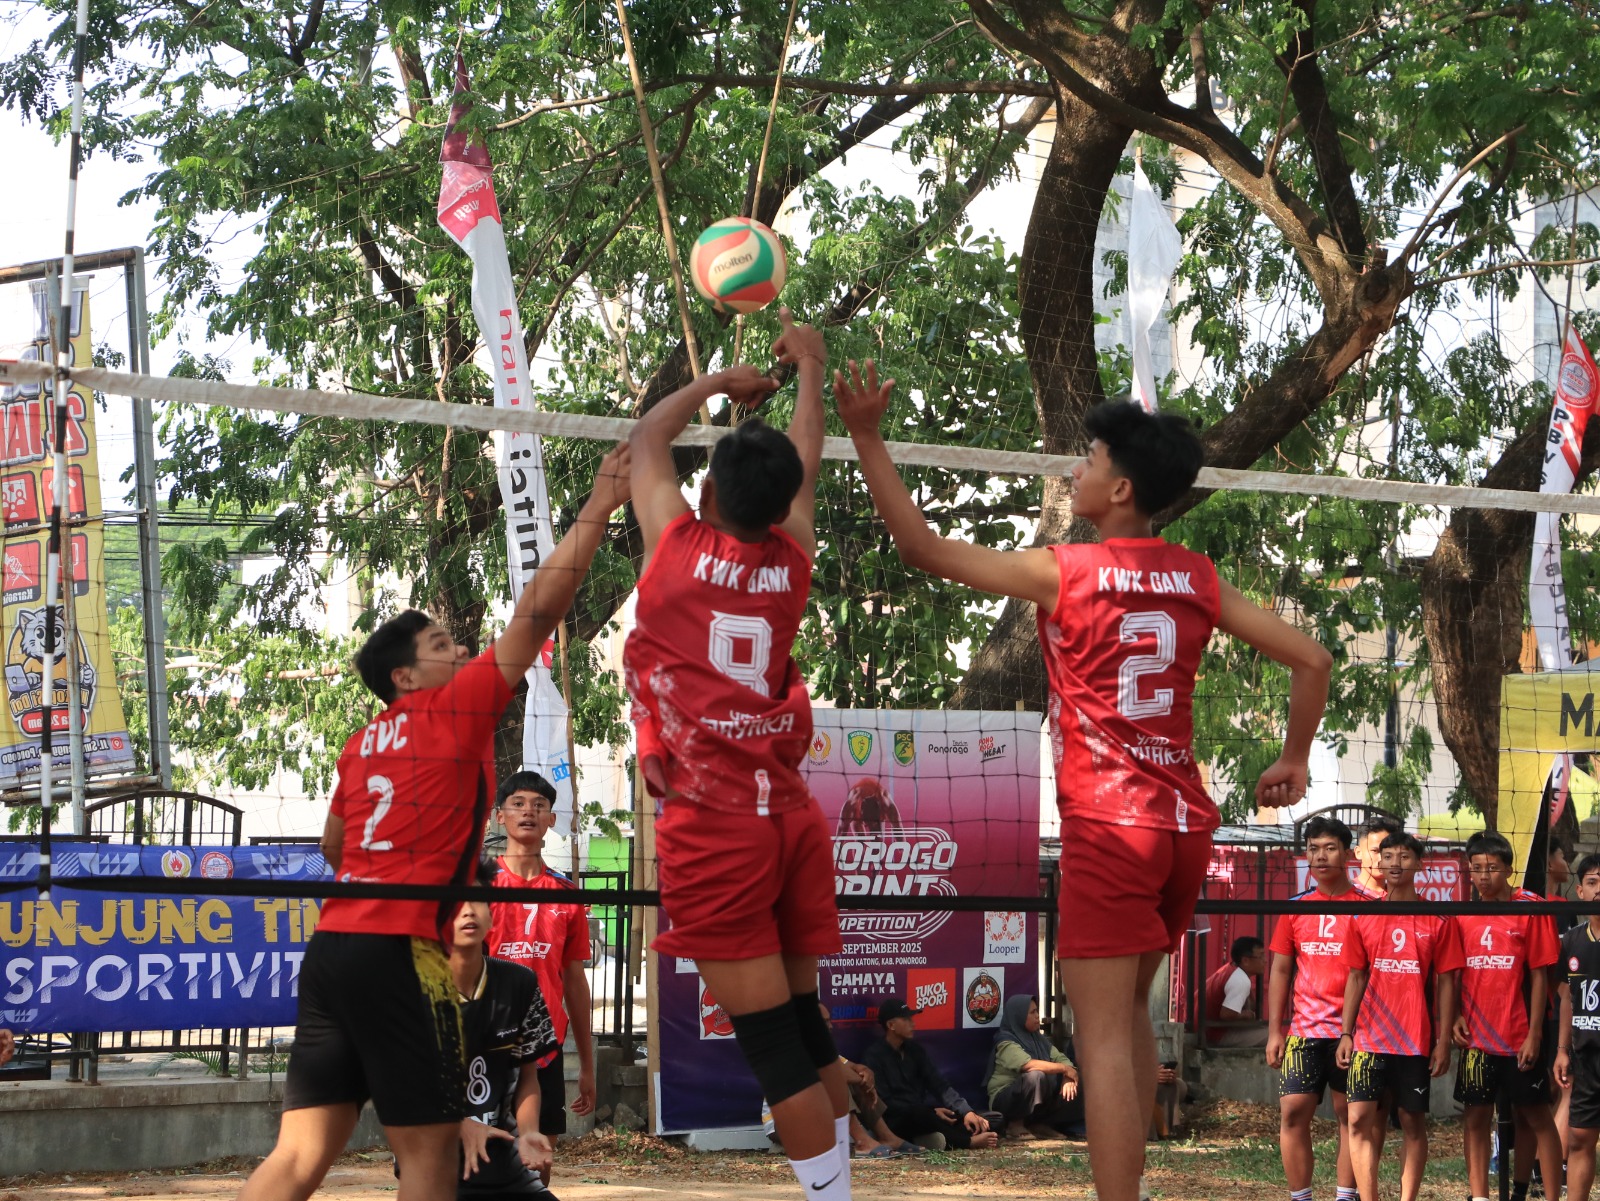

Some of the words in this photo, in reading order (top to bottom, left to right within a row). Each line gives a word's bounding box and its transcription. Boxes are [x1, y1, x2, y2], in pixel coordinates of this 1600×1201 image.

[714, 253, 753, 273] molten
[1539, 408, 1570, 486] PBVS
[693, 552, 745, 590] KWK
[1098, 567, 1144, 593] KWK
[1149, 571, 1196, 594] GANK
[1117, 611, 1176, 720] 2
[1559, 692, 1600, 737] M
[896, 734, 912, 742] PSC
[360, 775, 395, 851] 2
[0, 899, 233, 948] UNJUNG
[523, 904, 539, 935] 7
[1318, 915, 1335, 938] 12
[842, 943, 899, 955] SEPTEMBER
[900, 942, 922, 953] 2025
[1300, 942, 1343, 953] GENS
[1391, 928, 1406, 953] 9
[1480, 926, 1493, 950] 4
[831, 958, 854, 967] BATORO
[855, 957, 880, 966] KATONG,
[881, 957, 894, 965] KAB.
[895, 956, 927, 965] PONOROGO
[989, 944, 1020, 956] Looper
[1467, 955, 1516, 967] GENSO
[831, 972, 895, 987] CAHAYA
[915, 981, 947, 998] TUKOL
[831, 987, 896, 996] GRAFIKA
[916, 993, 948, 1010] SPORT
[1580, 979, 1600, 1011] 16
[467, 1056, 491, 1105] 8
